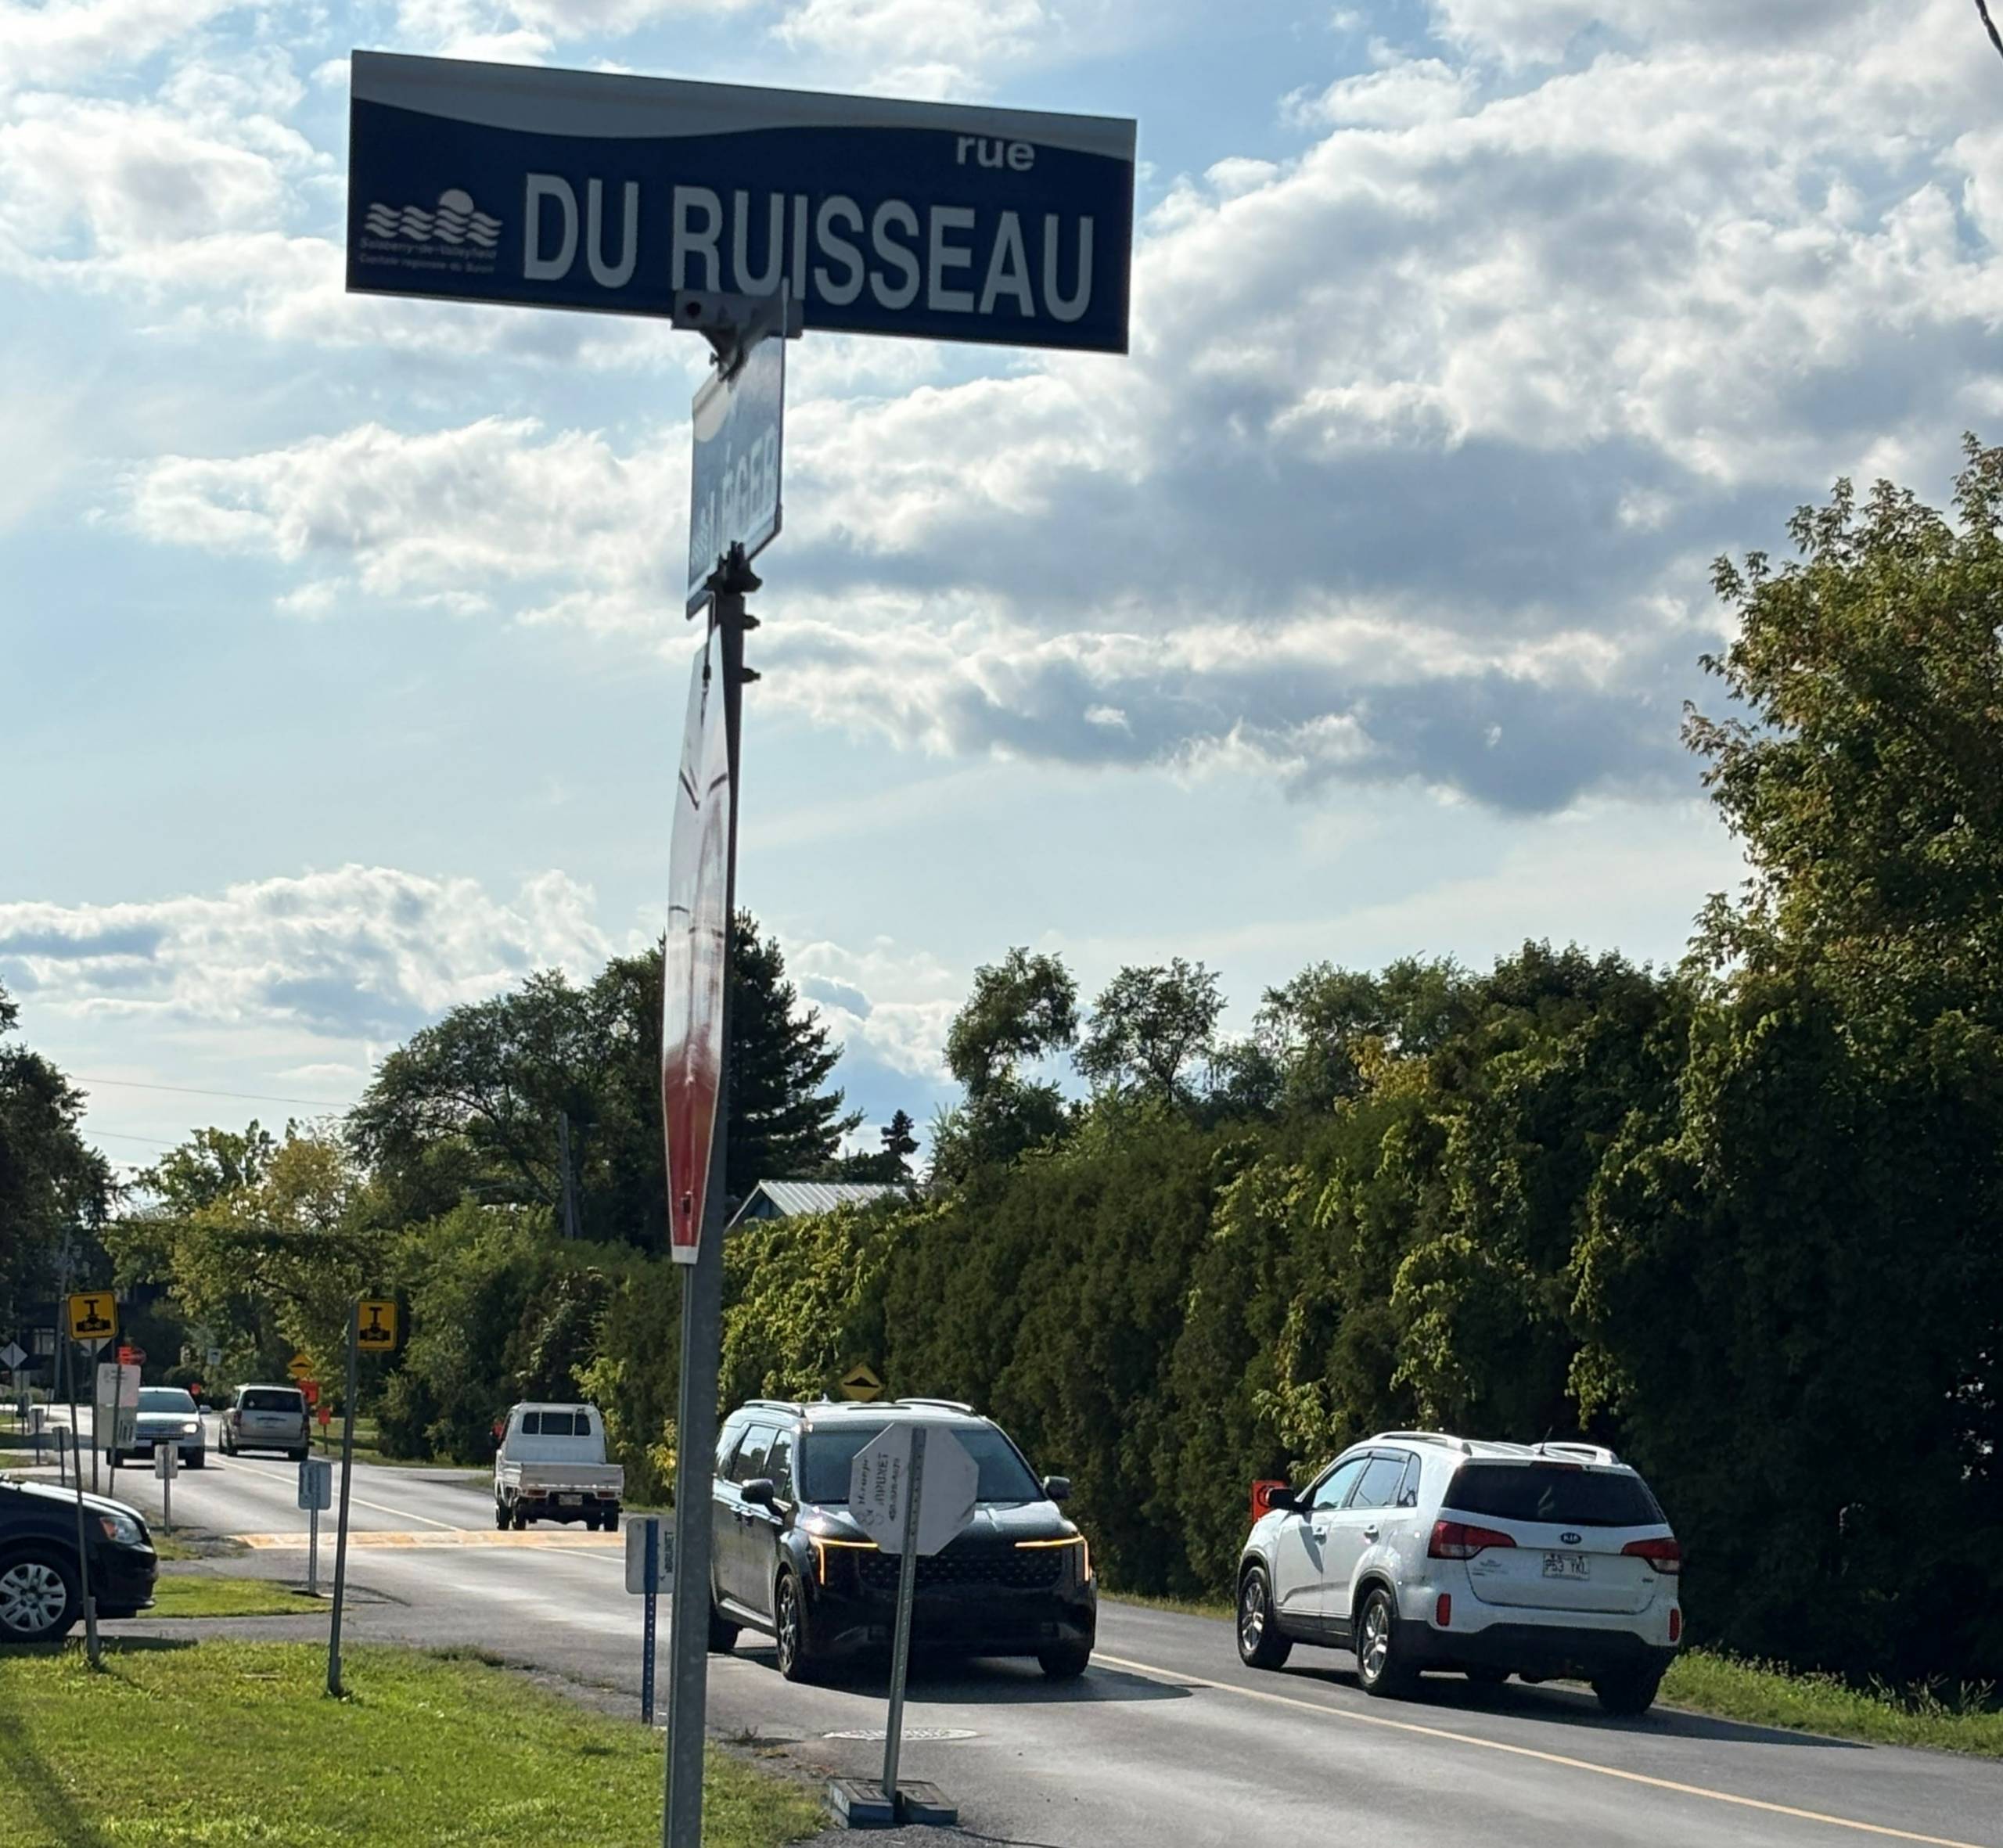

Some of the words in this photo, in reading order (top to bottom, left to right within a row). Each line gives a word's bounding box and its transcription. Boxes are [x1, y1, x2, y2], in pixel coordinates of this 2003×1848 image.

[957, 136, 1034, 171] rue
[523, 173, 638, 289] DU
[671, 185, 1094, 322] RUISSEAU
